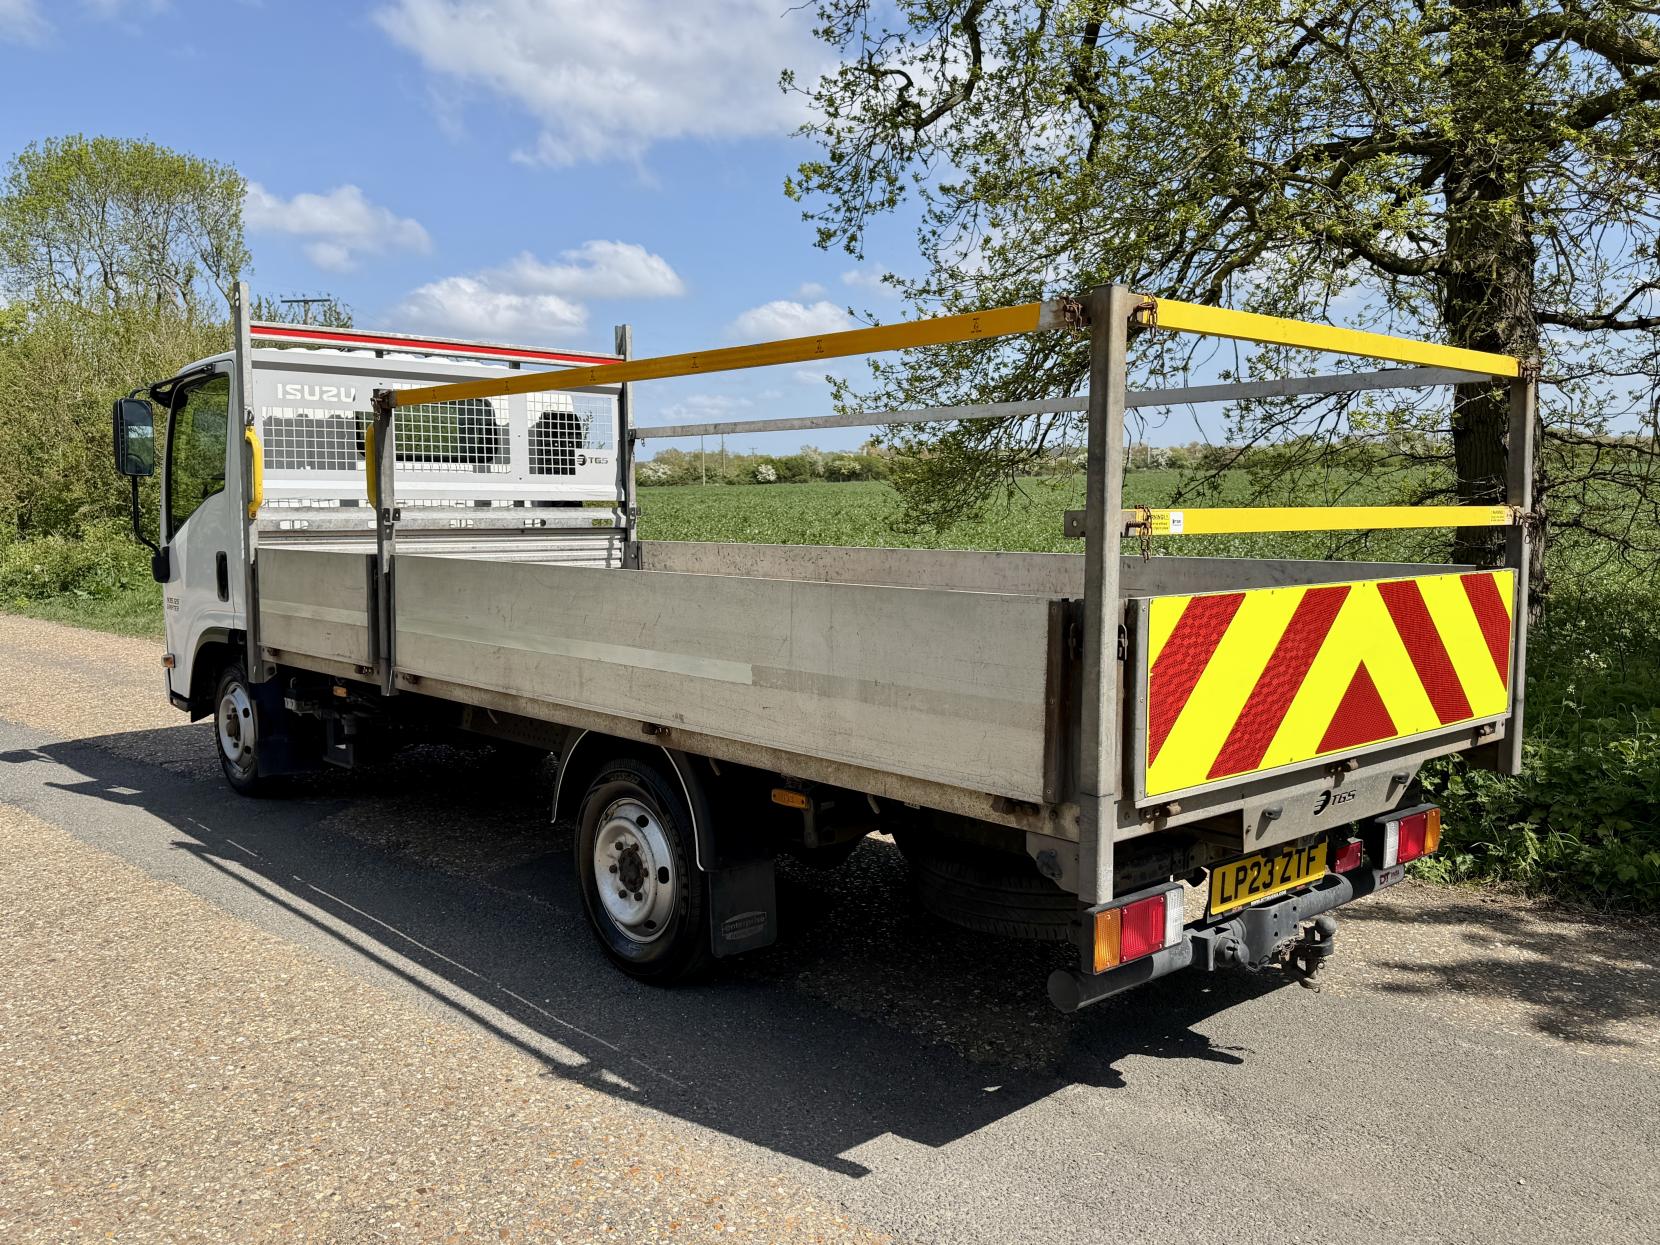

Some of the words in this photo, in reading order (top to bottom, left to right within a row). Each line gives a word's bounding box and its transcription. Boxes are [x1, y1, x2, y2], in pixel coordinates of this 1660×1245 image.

[277, 383, 356, 403] ISUZU
[588, 456, 609, 465] TGS
[1331, 789, 1357, 806] TGS
[1220, 859, 1275, 904] LP23
[1279, 844, 1320, 885] ZTF
